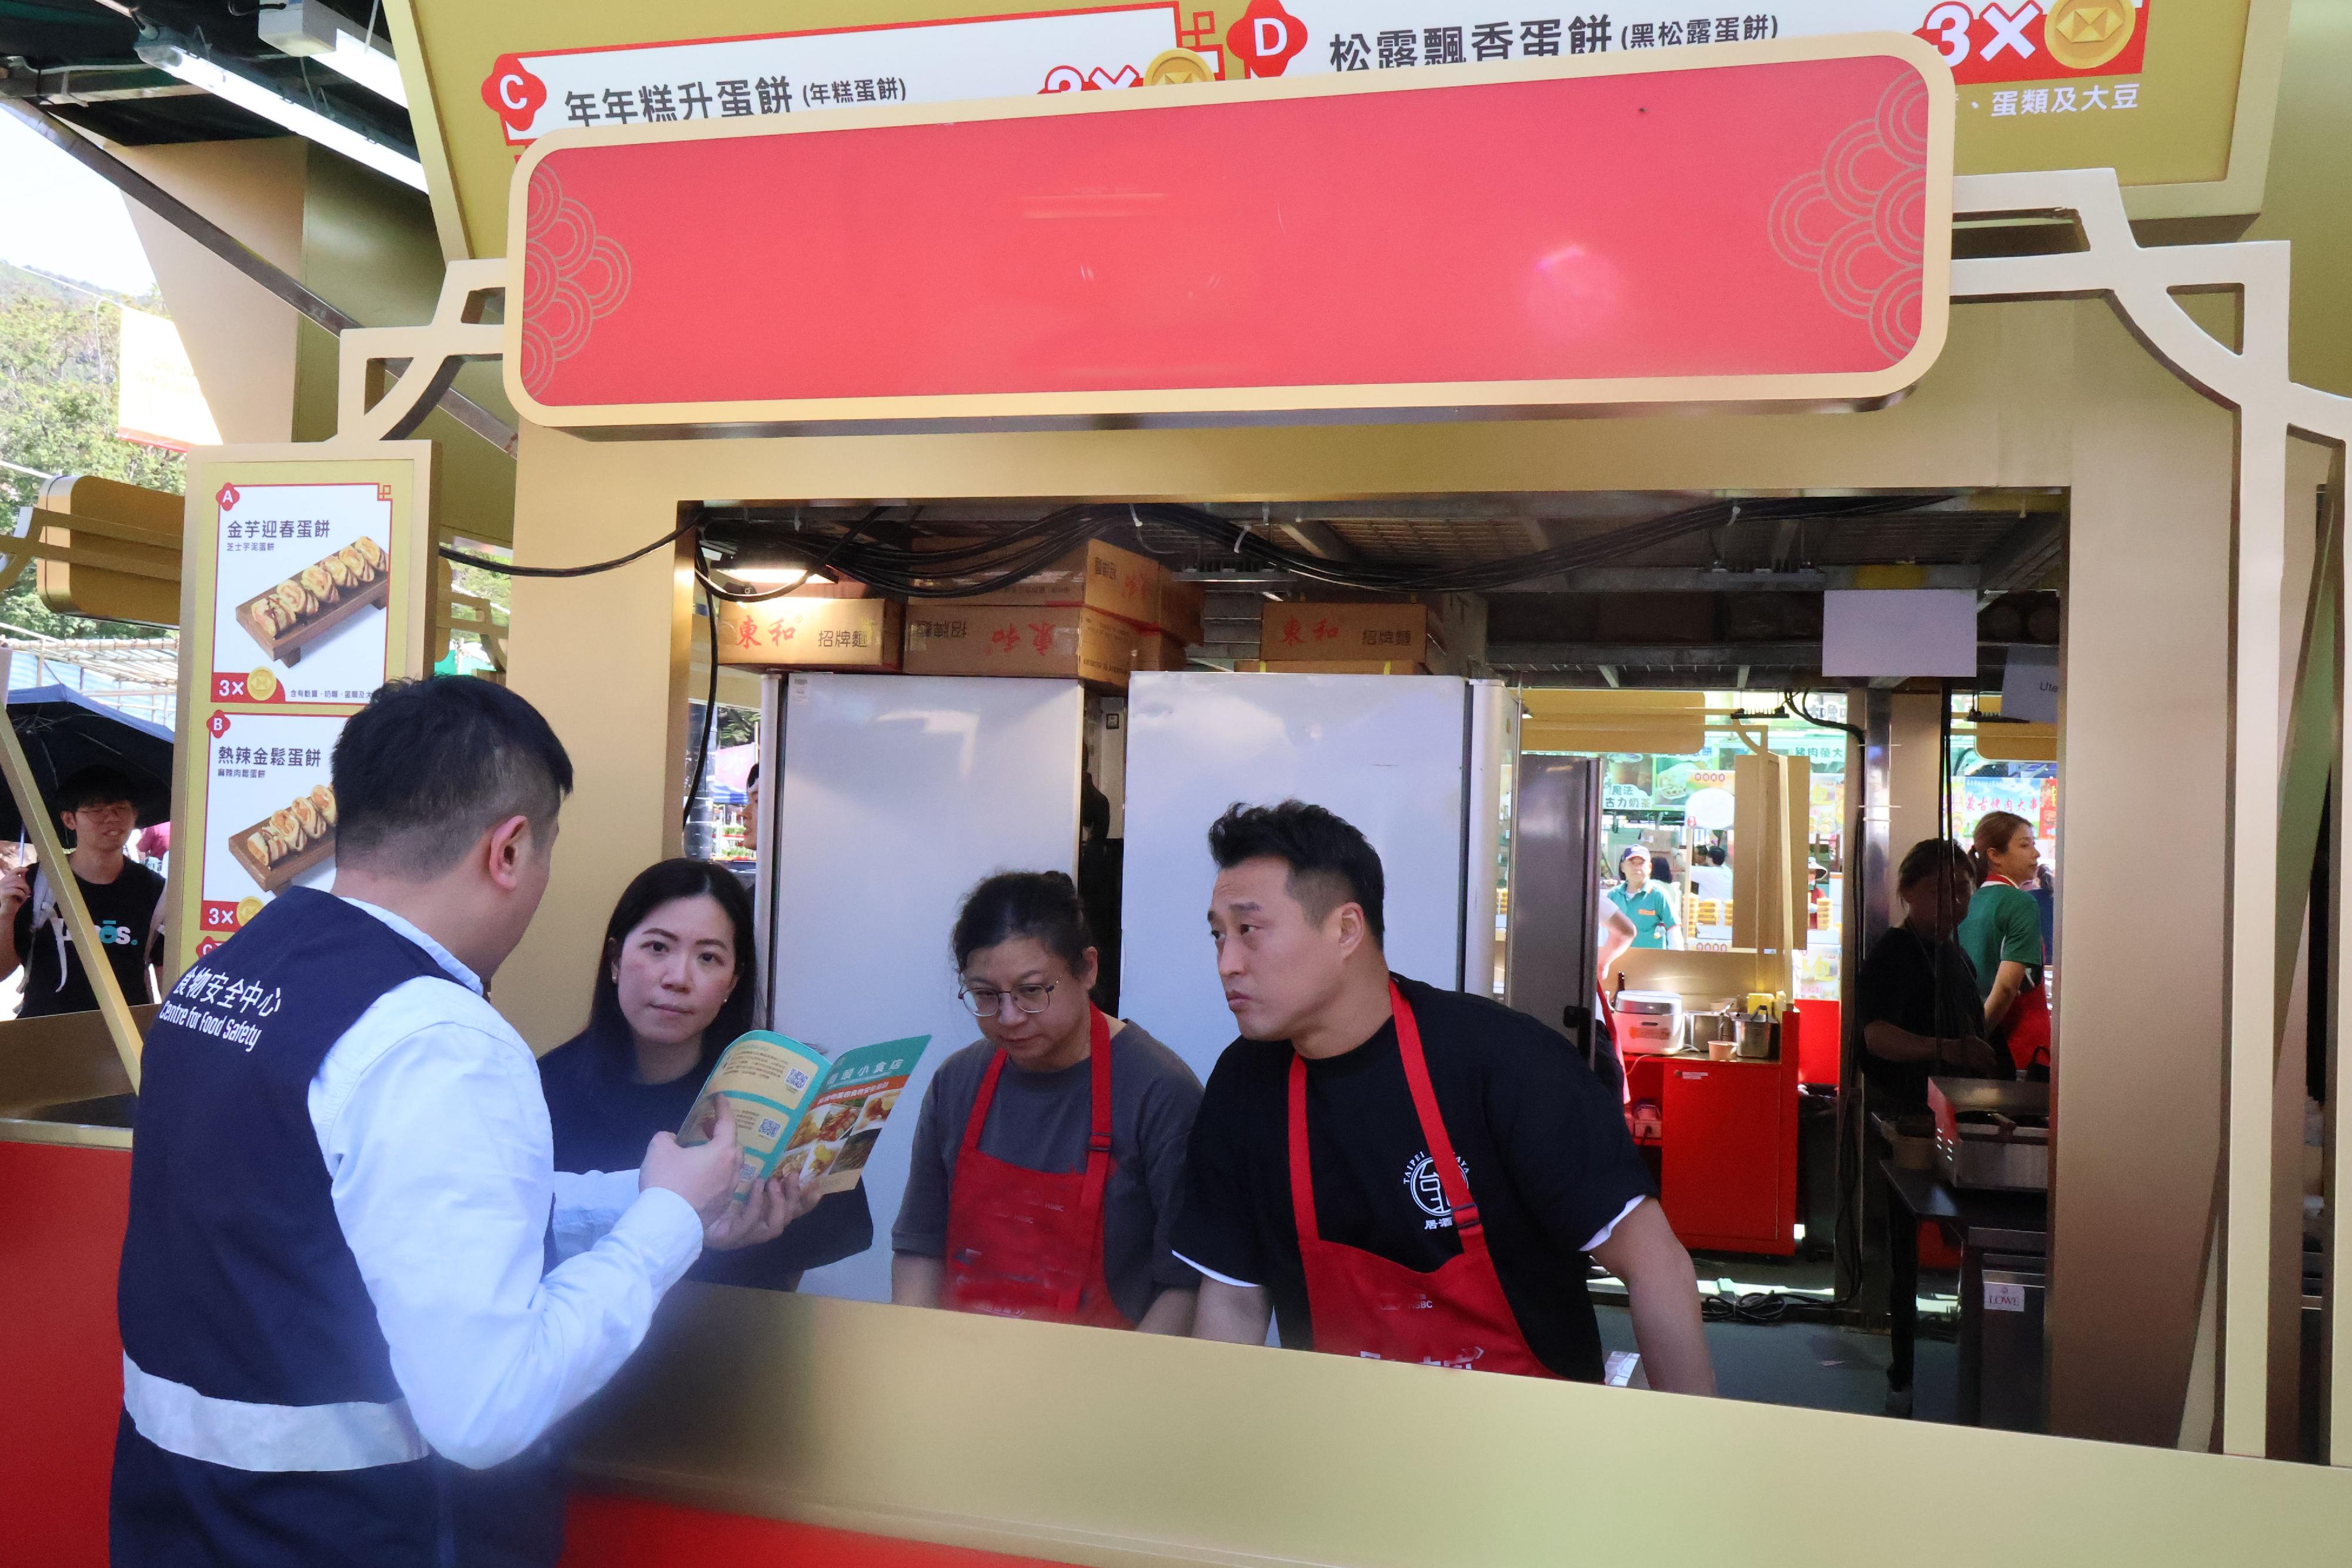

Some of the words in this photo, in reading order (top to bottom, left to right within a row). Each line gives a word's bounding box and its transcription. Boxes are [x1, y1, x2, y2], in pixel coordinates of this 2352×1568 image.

[1253, 17, 1288, 57] D
[1621, 15, 1778, 50] (黑松露蛋餅)
[500, 73, 527, 111] C
[564, 76, 792, 127] 年年糕升蛋餅
[803, 78, 906, 105] (年糕蛋餅)
[1955, 83, 2140, 117] 、蛋類及大豆
[222, 490, 233, 503] A
[227, 520, 330, 539] 金芋迎春蛋餅
[213, 718, 223, 730] B
[218, 746, 321, 767] 熱辣金鬆蛋餅
[173, 965, 281, 1017] 食物安全中心
[159, 1000, 189, 1025] Centre
[186, 1006, 202, 1029] for
[199, 1011, 228, 1037] Food
[222, 1019, 262, 1052] Safety
[1403, 1151, 1425, 1184] TAIPEI
